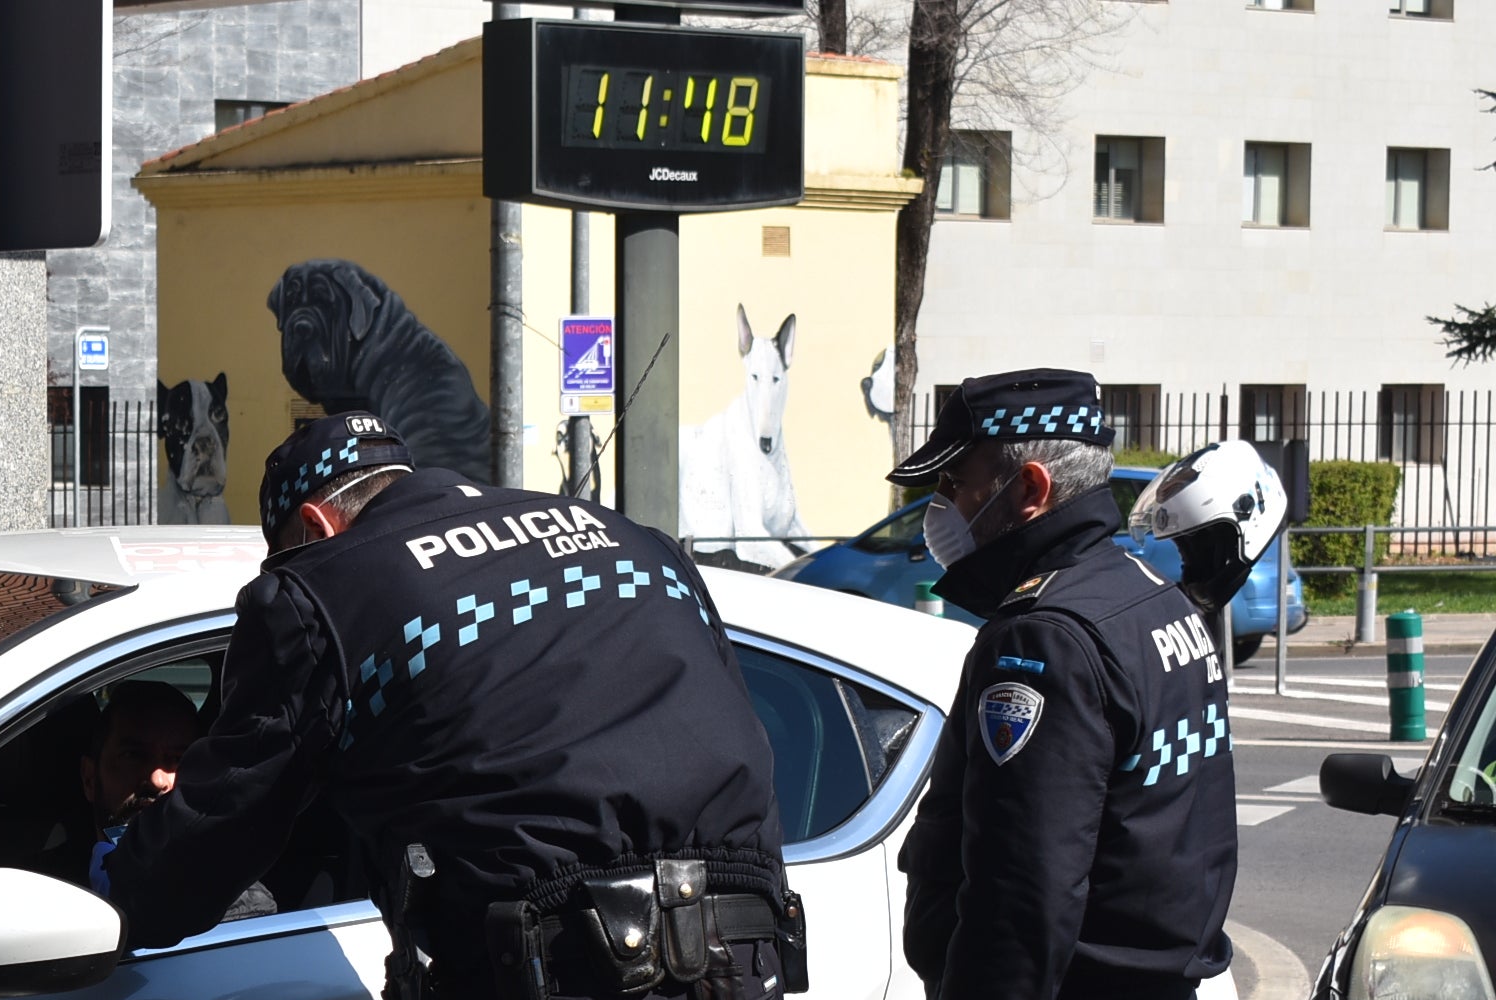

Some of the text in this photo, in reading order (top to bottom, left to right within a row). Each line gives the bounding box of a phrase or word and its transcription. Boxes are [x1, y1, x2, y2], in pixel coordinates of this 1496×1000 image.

[592, 72, 760, 147] 11:48
[648, 168, 698, 182] JCDecaux
[564, 323, 612, 335] ATENCIÓN
[351, 418, 383, 433] CPL
[405, 505, 607, 570] POLICIA
[542, 530, 620, 559] LOCAL
